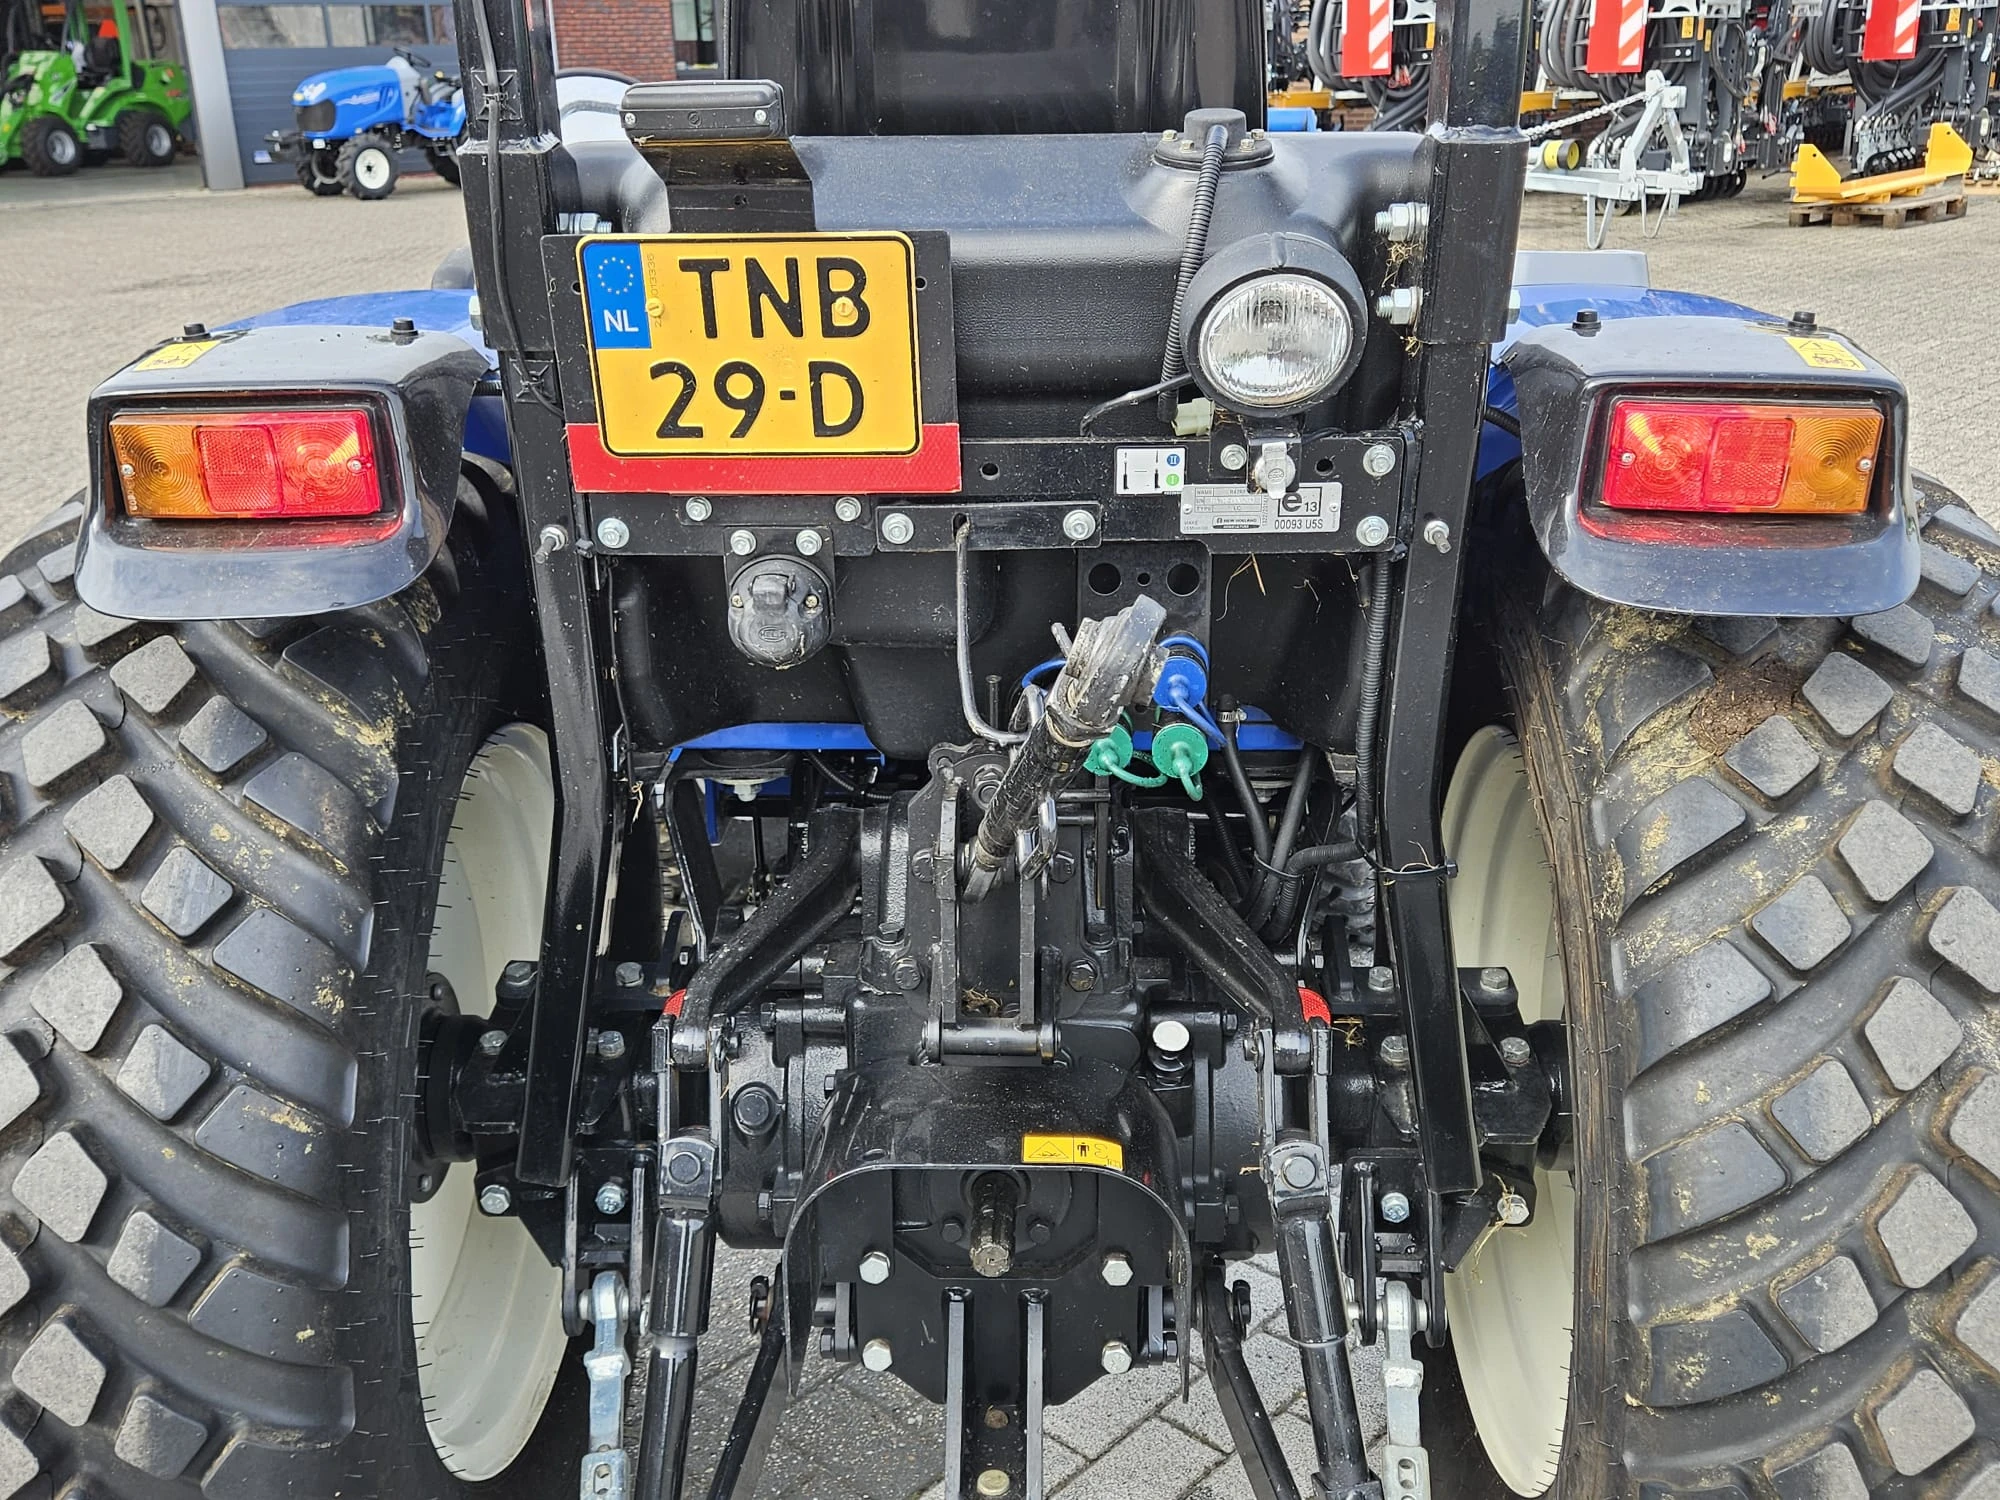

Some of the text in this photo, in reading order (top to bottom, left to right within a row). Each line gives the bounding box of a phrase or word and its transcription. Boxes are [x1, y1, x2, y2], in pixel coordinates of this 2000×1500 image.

[678, 256, 871, 339] TNB
[603, 310, 639, 333] NL
[649, 360, 865, 439] 29-D
[1304, 502, 1318, 513] 13
[1274, 519, 1303, 530] 00093
